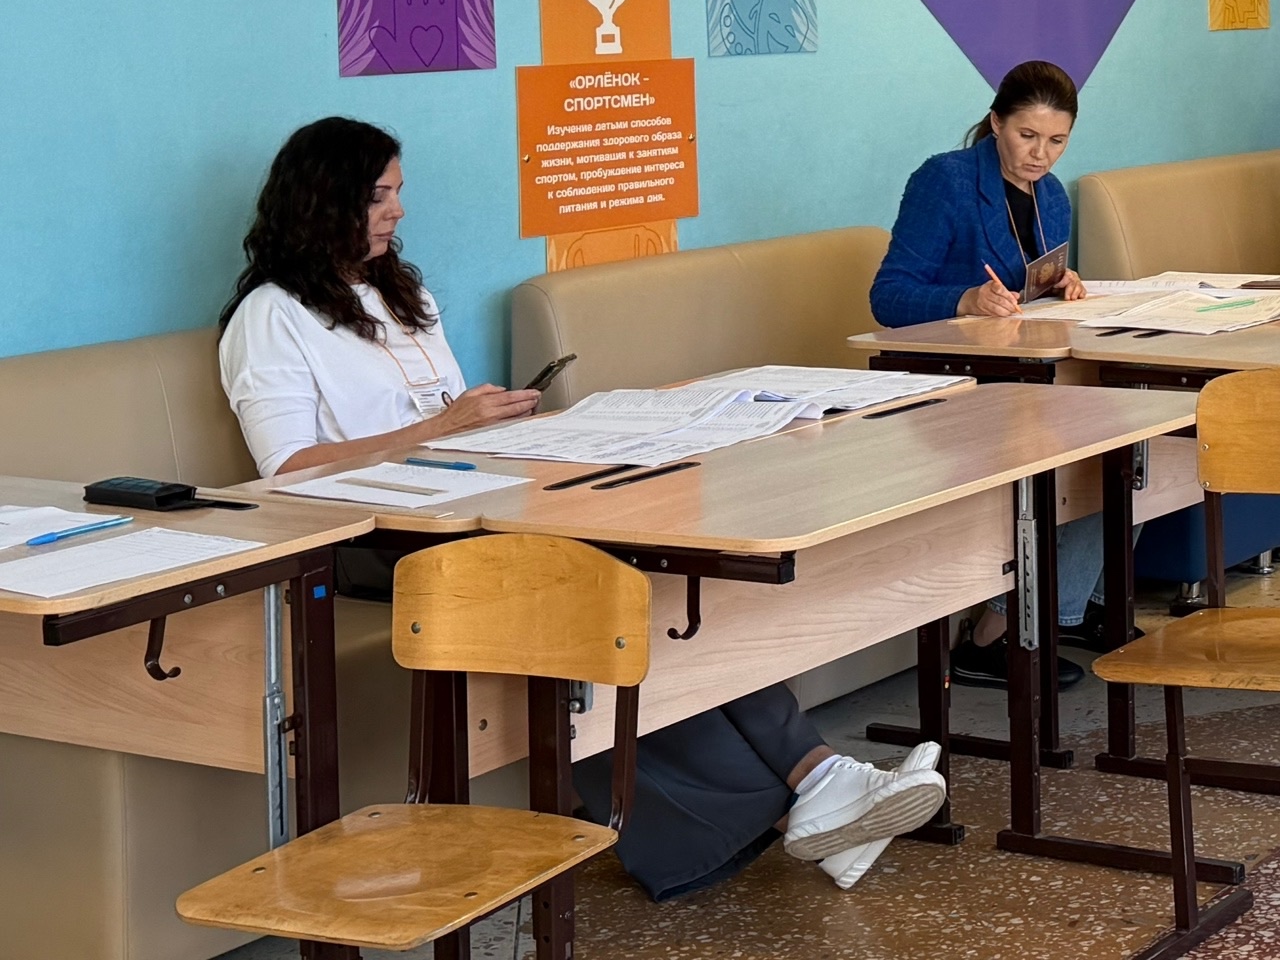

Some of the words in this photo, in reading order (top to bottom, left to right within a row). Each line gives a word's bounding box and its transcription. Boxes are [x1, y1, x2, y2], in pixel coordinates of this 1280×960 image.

[570, 72, 640, 89] «ОРЛЁНОК
[564, 93, 655, 111] СПОРТСМЕН»
[548, 123, 592, 136] Изучение
[595, 121, 628, 131] детьми
[631, 117, 671, 128] способов
[536, 139, 600, 152] поддержания
[603, 135, 649, 146] здорового
[652, 131, 682, 142] образа
[542, 158, 574, 168] жизни,
[577, 153, 626, 164] мотивация
[637, 147, 678, 158] занятиям
[535, 173, 578, 185] спортом,
[581, 166, 642, 180] пробуждение
[644, 161, 684, 173] интереса
[556, 185, 615, 198] соблюдению
[618, 177, 674, 191] правильного
[559, 202, 598, 214] питания
[609, 196, 644, 209] режима
[647, 194, 665, 203] дня.
